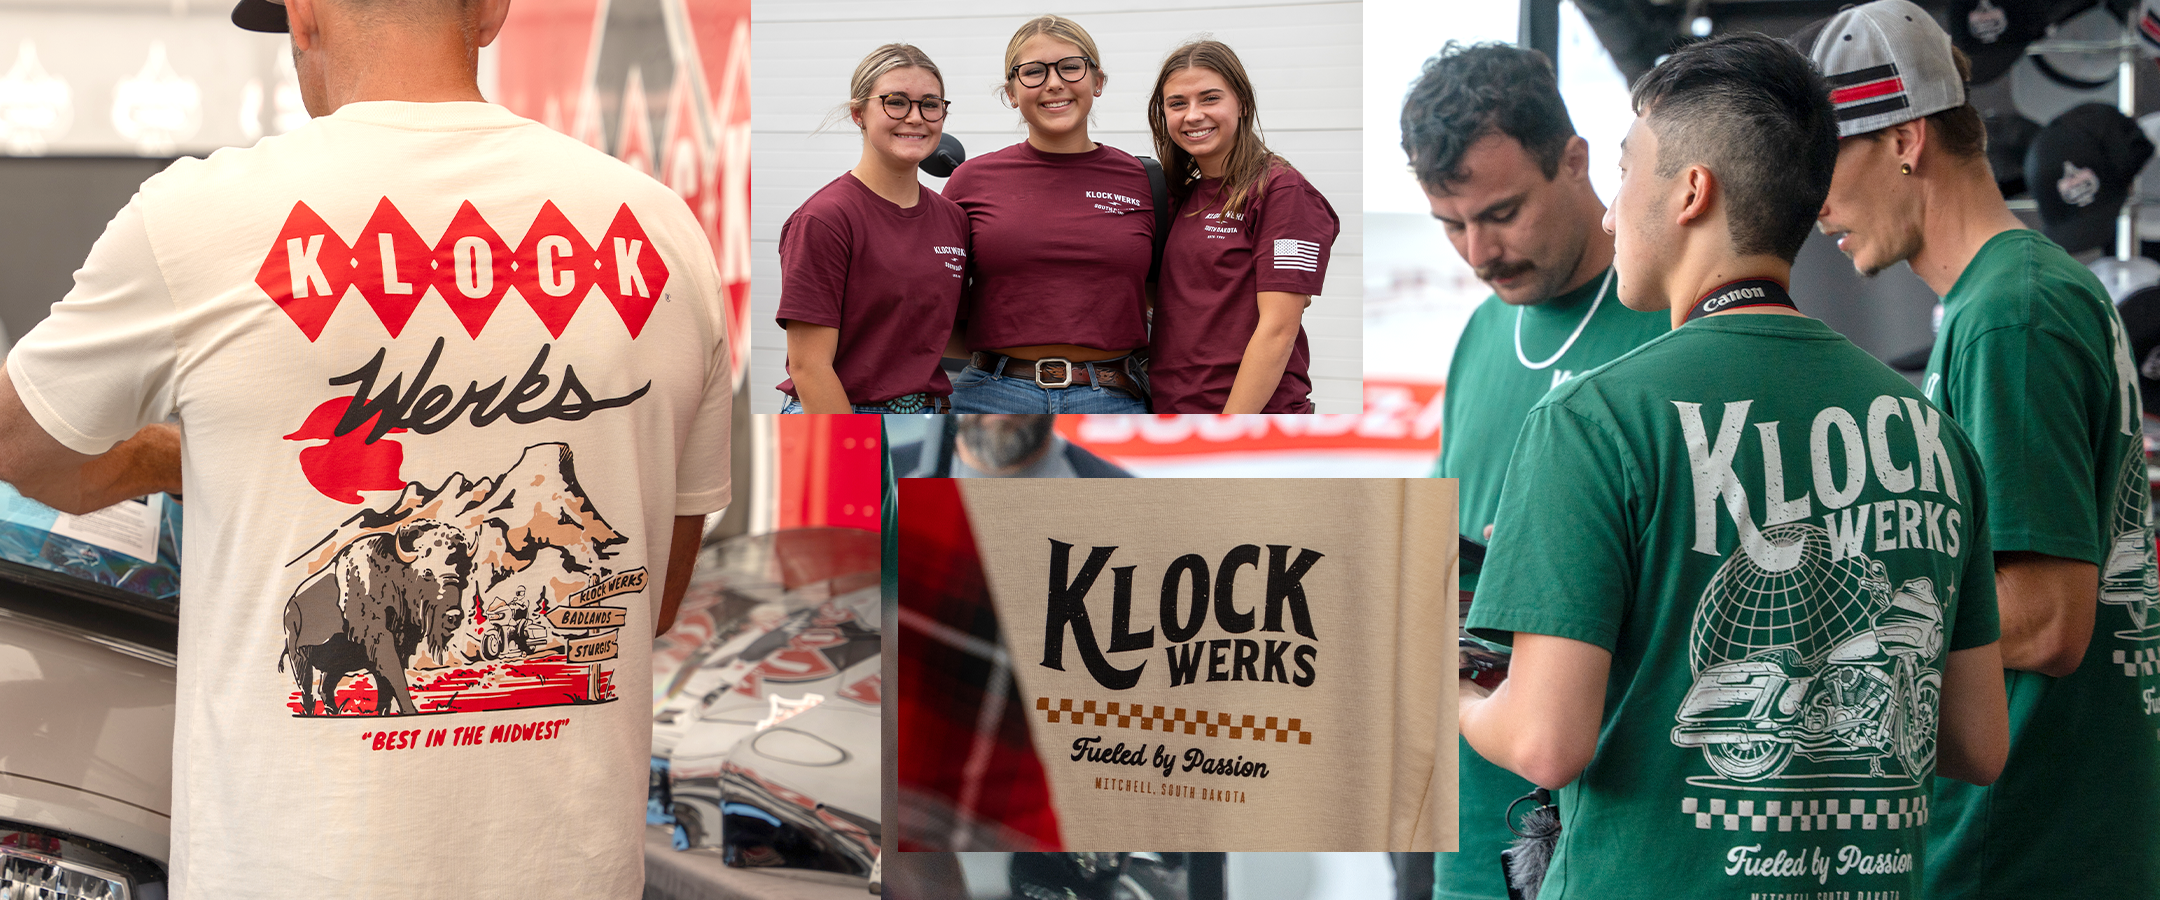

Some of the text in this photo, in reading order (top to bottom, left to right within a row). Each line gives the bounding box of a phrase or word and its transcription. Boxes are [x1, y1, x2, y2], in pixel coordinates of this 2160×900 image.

[1085, 190, 1141, 207] KLOCK WERKS
[286, 231, 651, 299] KLOCK
[1702, 286, 1765, 312] Canon
[328, 336, 652, 445] Werks
[1669, 394, 1962, 573] KLOCK
[1822, 498, 1962, 563] WERKS
[580, 572, 644, 603] KLOCK WERKS
[561, 610, 612, 625] BADLANDS
[1039, 537, 1326, 691] KLOCK
[574, 640, 612, 657] STURGIS
[1164, 638, 1318, 688] WERKS
[425, 728, 447, 748] IN
[453, 725, 486, 746] THE
[1070, 735, 1270, 778] Fueled by Passion
[1160, 784, 1196, 799] SOUTH
[1201, 788, 1246, 804] DAKOTA
[1724, 843, 1913, 885] Fueled by Passion
